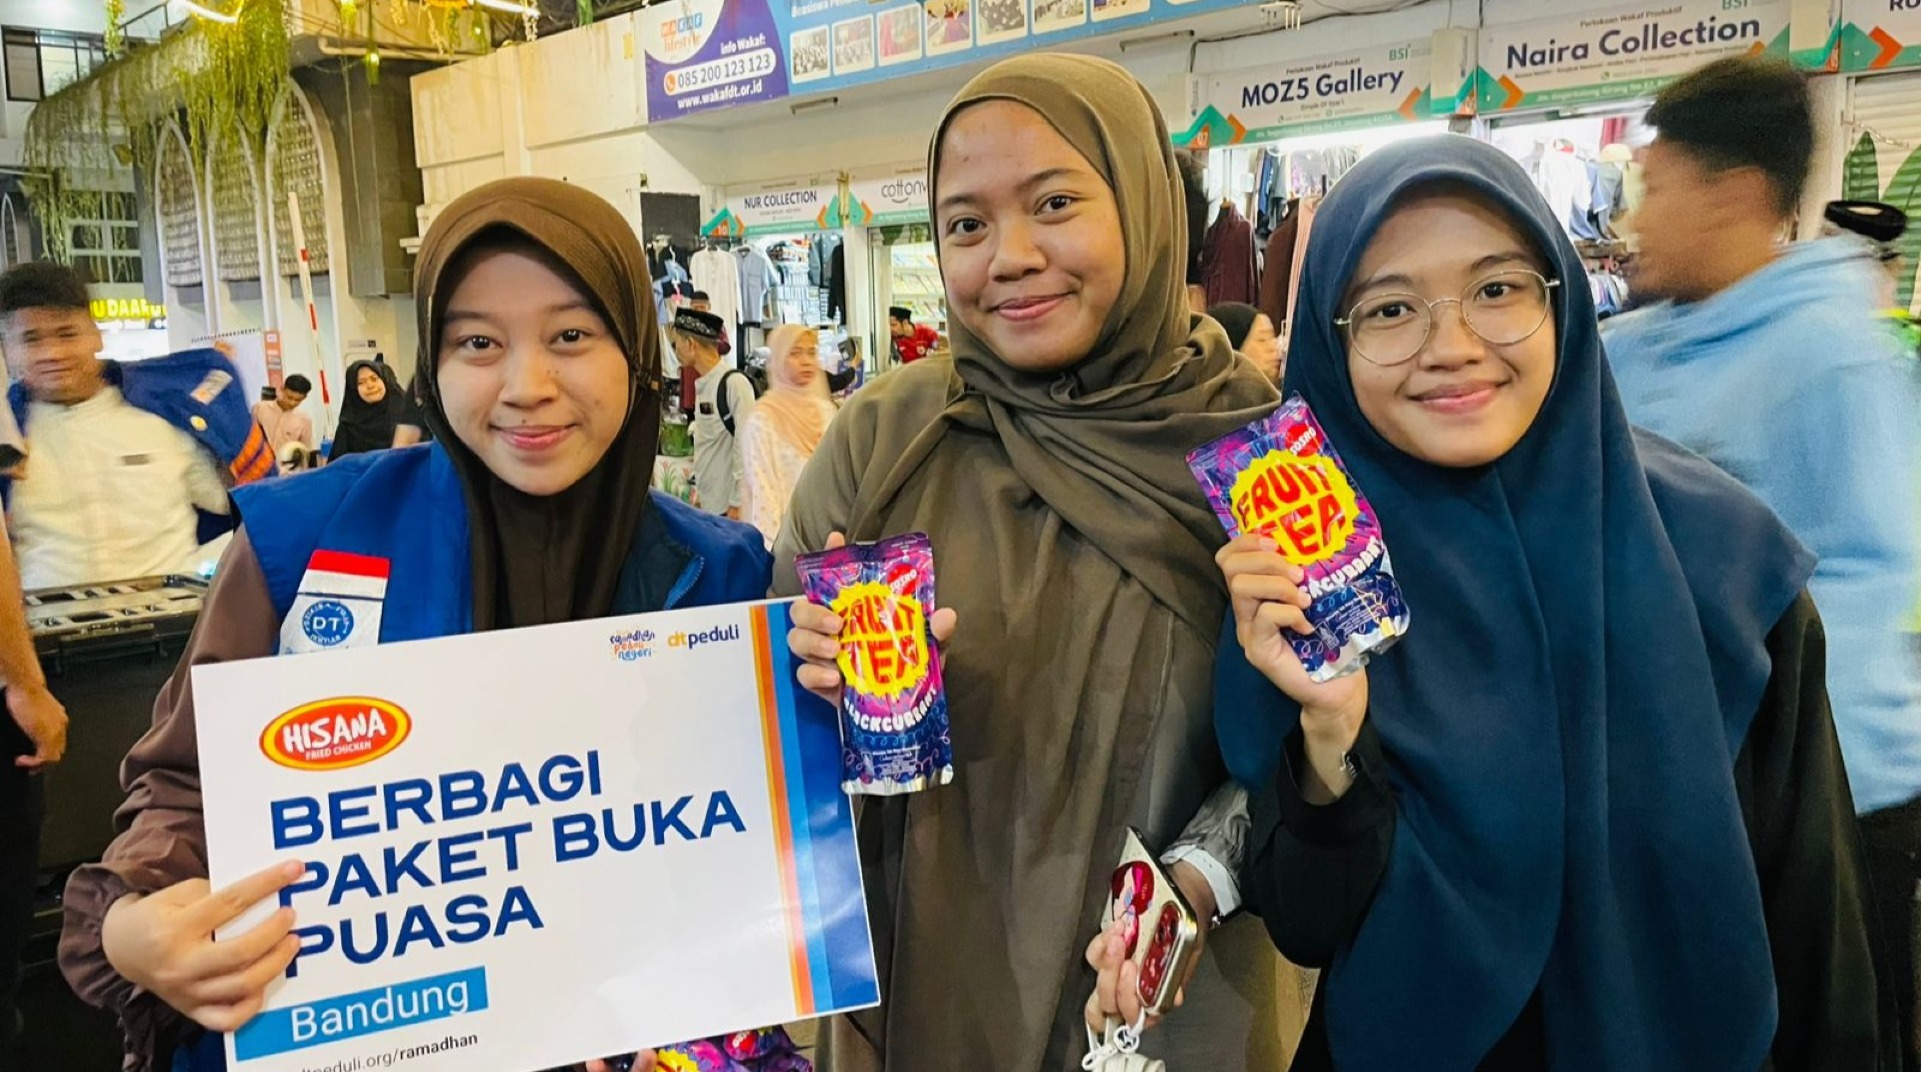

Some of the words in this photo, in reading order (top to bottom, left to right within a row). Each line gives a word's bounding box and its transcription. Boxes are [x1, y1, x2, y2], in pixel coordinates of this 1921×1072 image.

[720, 42, 737, 55] info
[1389, 47, 1409, 61] BSI
[1507, 39, 1589, 69] Naira
[1599, 16, 1760, 56] Collection
[678, 70, 701, 88] 085
[701, 66, 721, 84] 200
[724, 60, 745, 78] 123
[748, 53, 770, 73] 123
[1241, 77, 1310, 109] MOZ5
[1315, 67, 1404, 97] Gallery
[677, 79, 762, 109] www.wakafdt.or.id
[744, 196, 763, 209] NUR
[764, 190, 817, 208] COLLECTION
[1236, 461, 1331, 529] FRUIT
[1252, 493, 1347, 557] TEA
[312, 616, 341, 632] DT
[838, 594, 917, 637] FRUIT
[840, 634, 919, 684] TEA
[283, 707, 387, 754] HISANA
[305, 747, 331, 761] FRIED
[333, 740, 372, 756] CHICKEN
[270, 749, 602, 850] BERBAGI
[278, 822, 533, 908] PAKET
[552, 790, 747, 862] BUKA
[285, 885, 544, 979] PUASA
[290, 978, 469, 1042] Bandung
